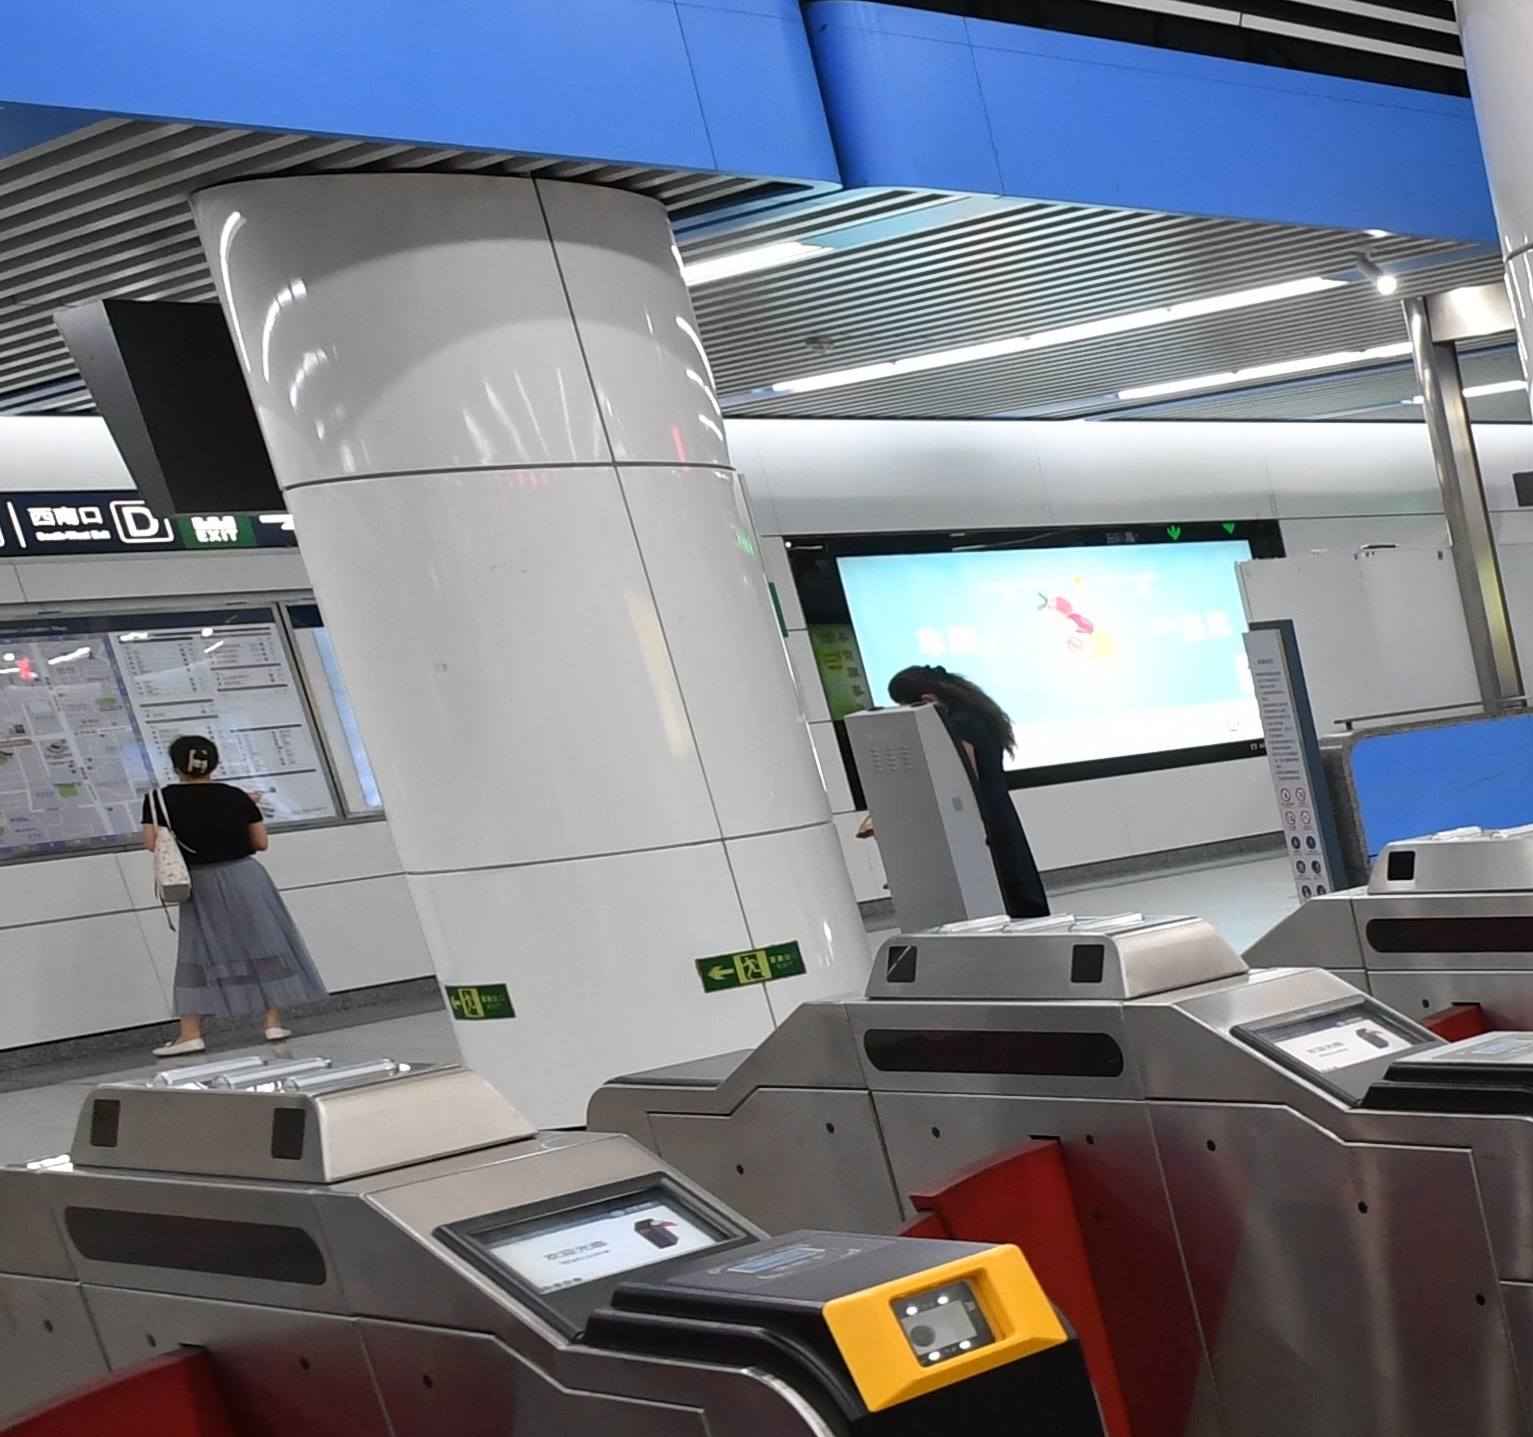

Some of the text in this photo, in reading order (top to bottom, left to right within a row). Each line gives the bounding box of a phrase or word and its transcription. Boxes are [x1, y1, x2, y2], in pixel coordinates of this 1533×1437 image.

[26, 505, 104, 527] 西南口
[120, 505, 160, 537] D
[195, 528, 238, 542] EXIT
